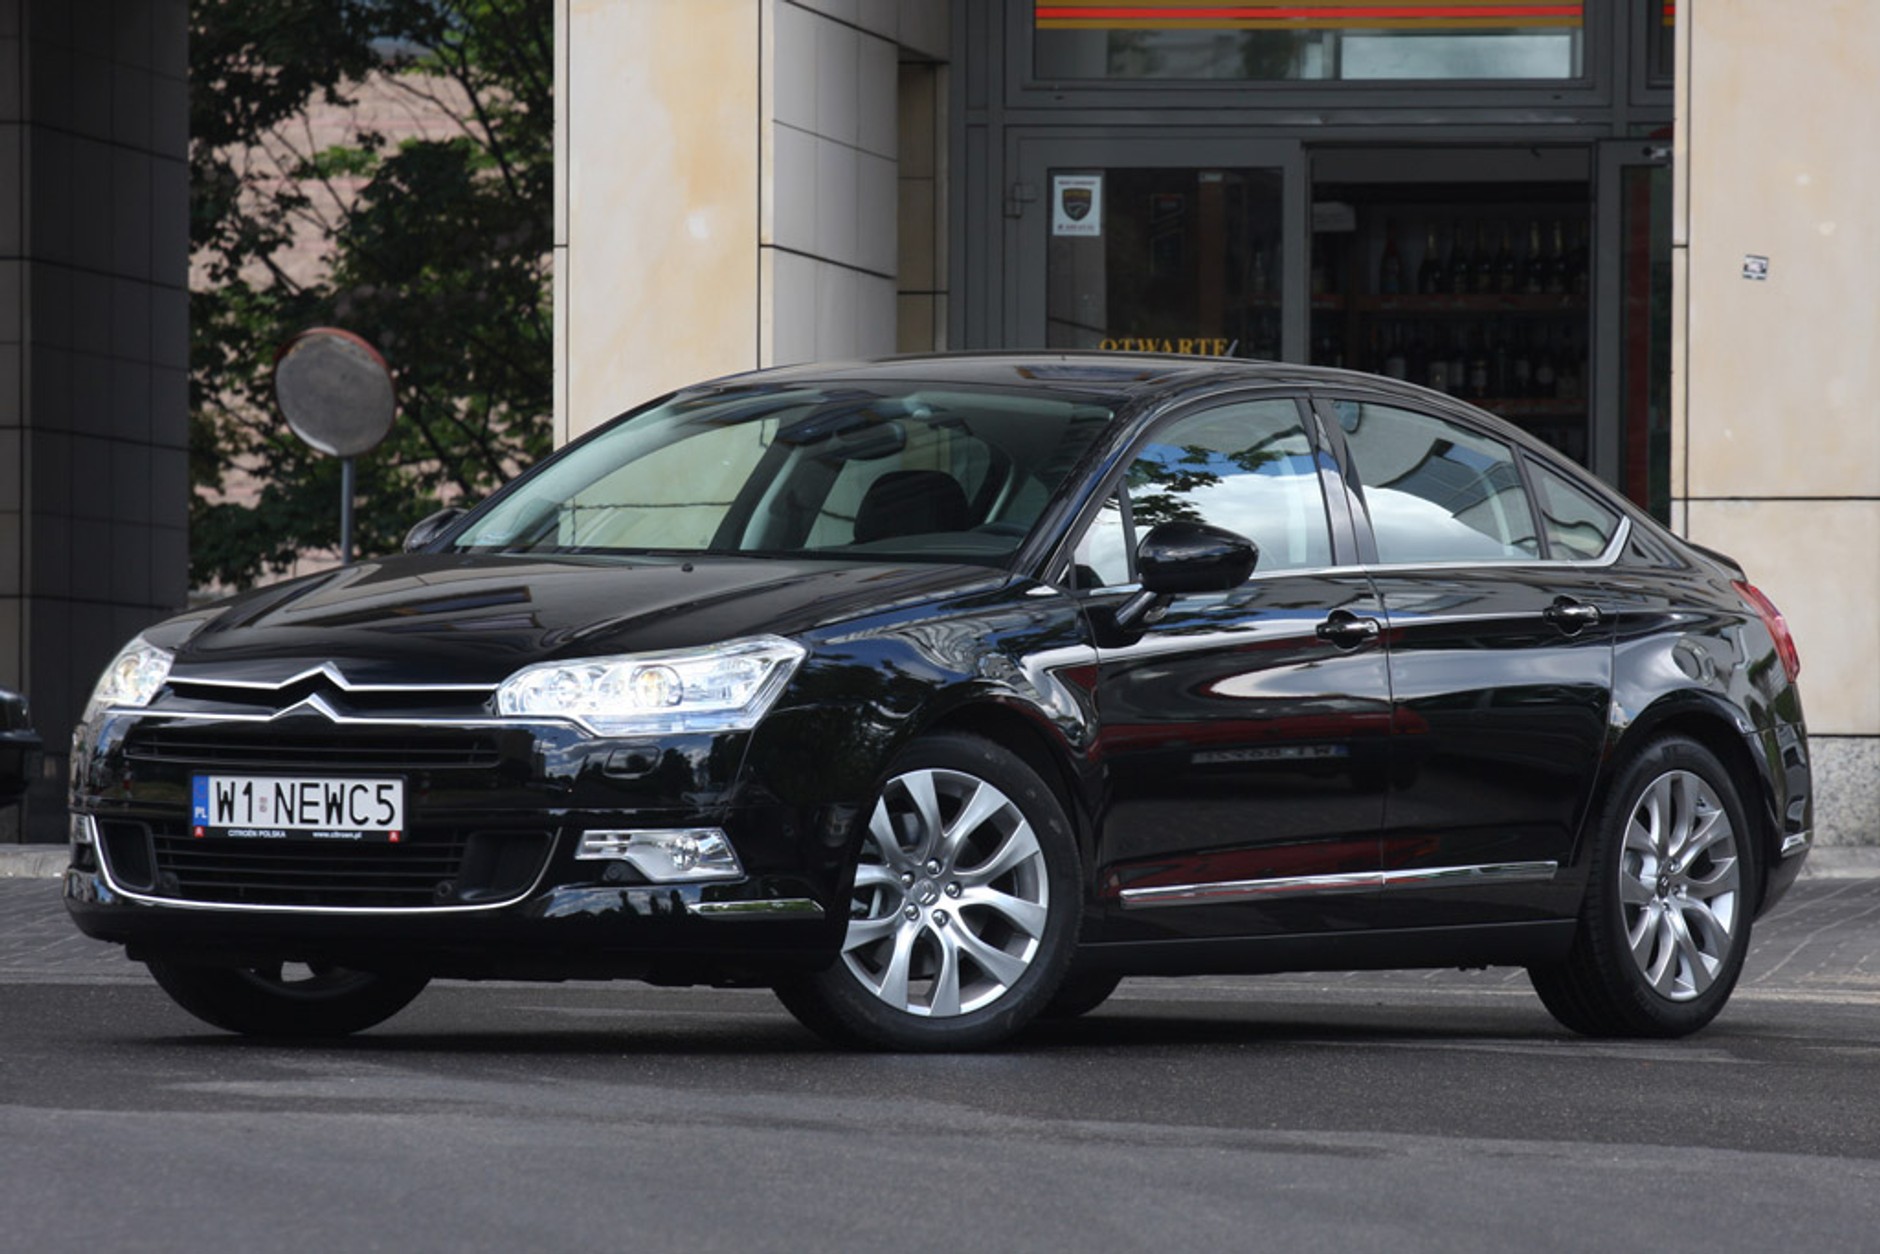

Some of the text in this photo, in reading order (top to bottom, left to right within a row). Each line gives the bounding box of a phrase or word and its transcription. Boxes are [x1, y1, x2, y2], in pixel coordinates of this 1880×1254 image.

[1099, 337, 1228, 356] OTWARTE
[216, 781, 396, 826] W1 NEWC5
[194, 806, 207, 819] PL
[258, 830, 287, 838] POLSKA
